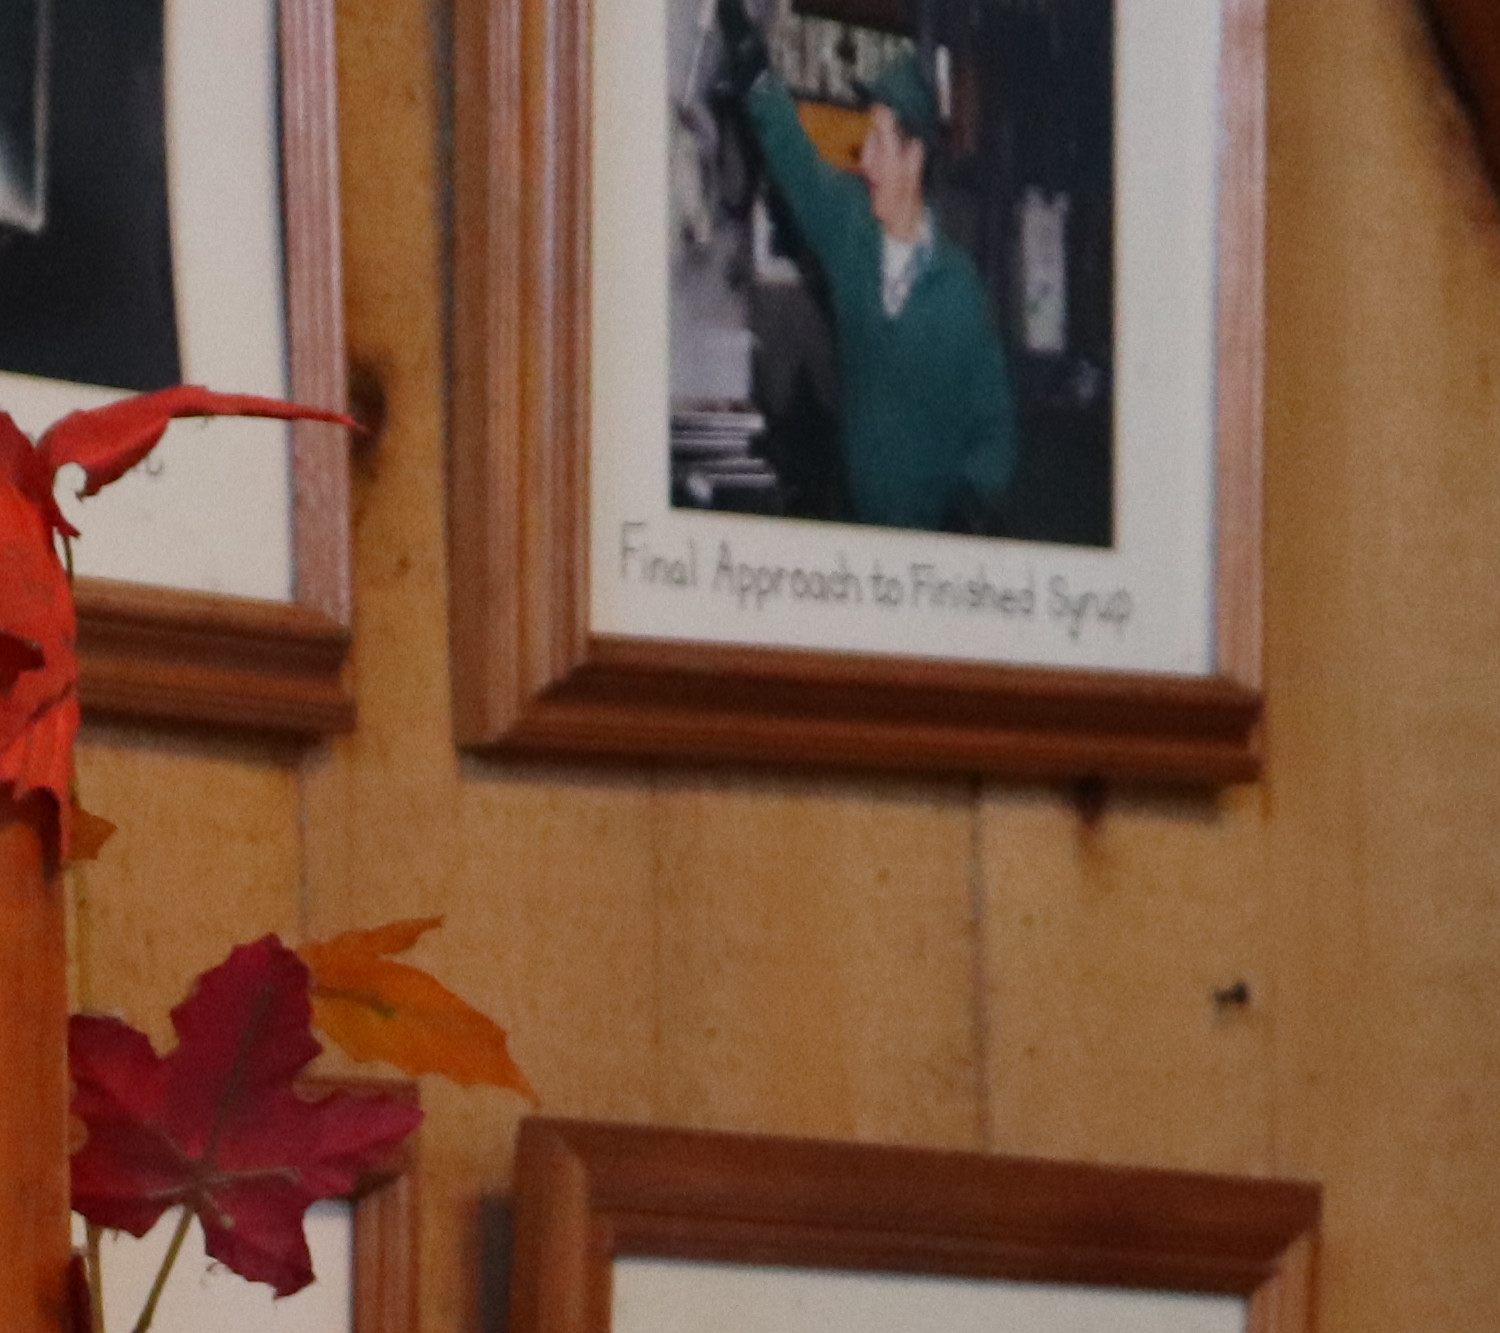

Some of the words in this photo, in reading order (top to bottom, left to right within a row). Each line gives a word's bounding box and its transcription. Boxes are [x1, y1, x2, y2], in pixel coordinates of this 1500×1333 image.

[619, 521, 698, 588] Final
[712, 540, 863, 611] Approach
[870, 557, 902, 606] to
[908, 561, 1036, 617] Finished
[1046, 573, 1133, 642] Syrup
